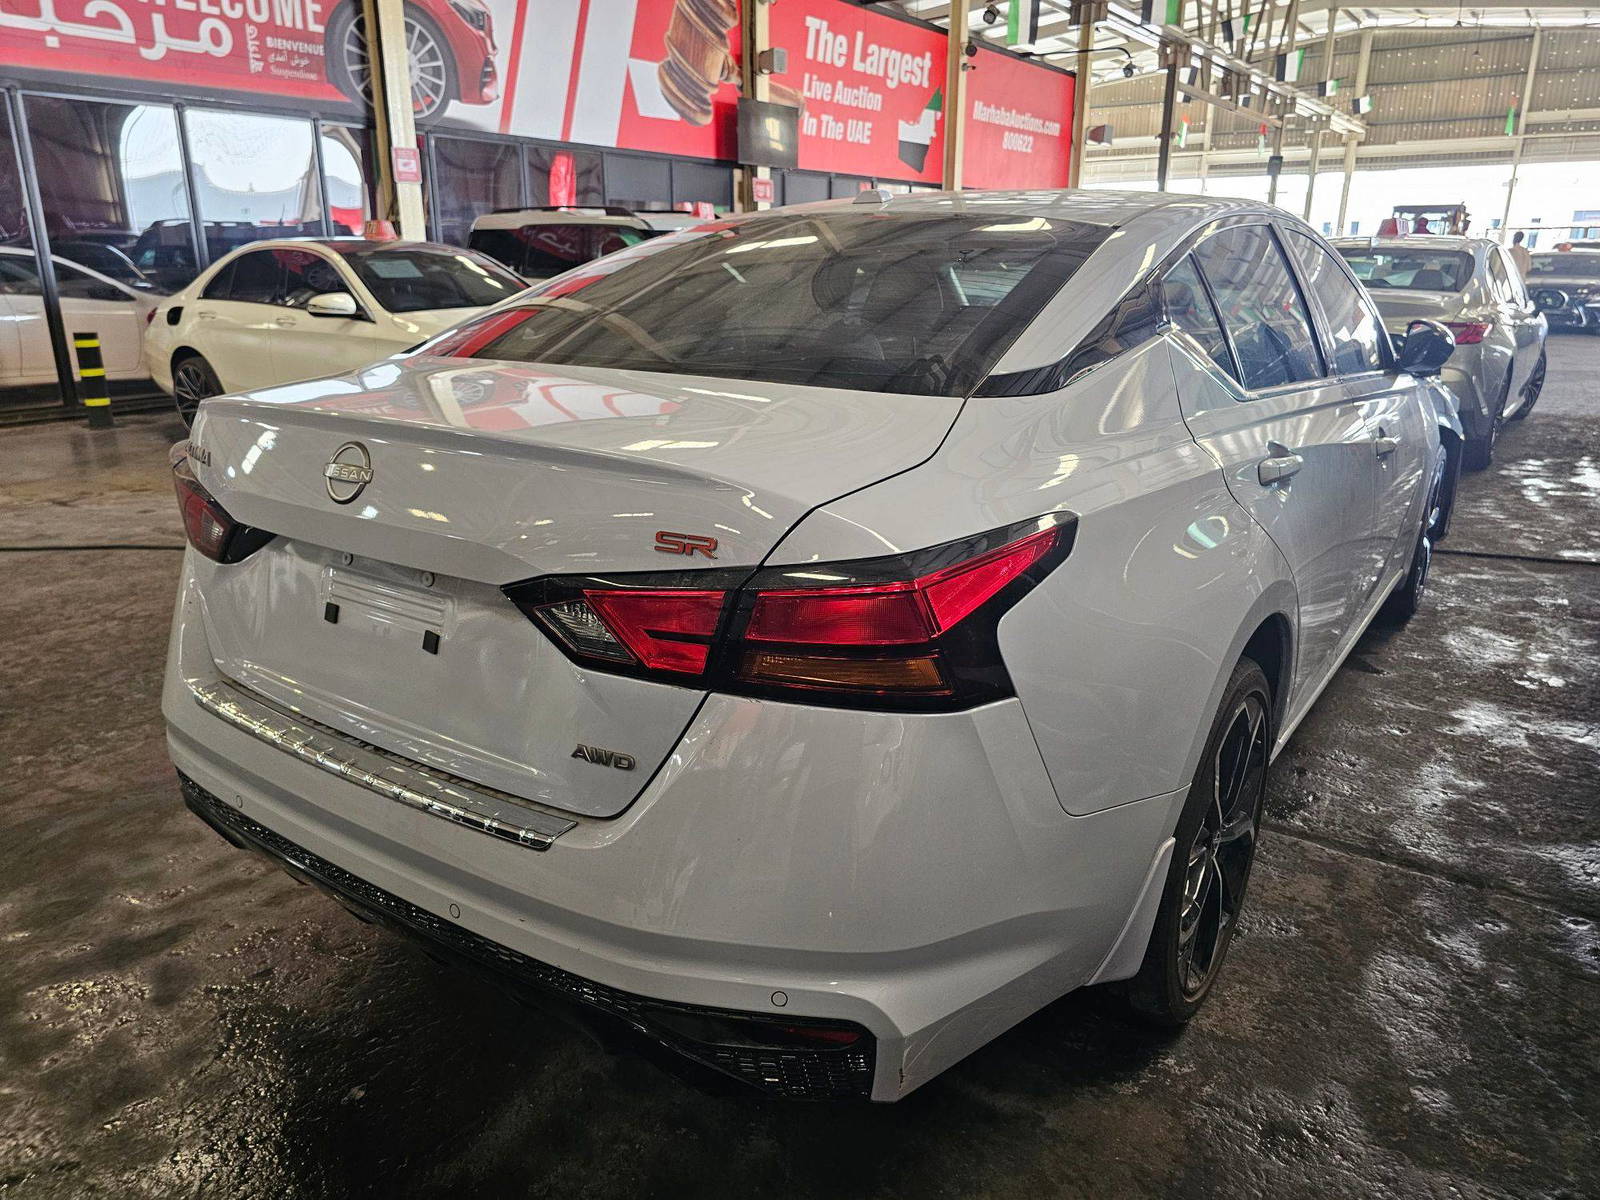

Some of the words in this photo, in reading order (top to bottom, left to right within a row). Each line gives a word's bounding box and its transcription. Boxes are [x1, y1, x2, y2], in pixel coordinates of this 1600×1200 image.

[0, 0, 233, 61] مرحب
[265, 36, 325, 57] BIENVENUE
[805, 15, 848, 68] The
[852, 30, 932, 89] Largest
[803, 72, 833, 102] Live
[833, 80, 882, 112] Auction
[802, 111, 817, 136] In
[820, 114, 844, 141] The
[847, 119, 872, 144] UAE
[654, 530, 719, 560] SR
[571, 743, 636, 771] AWD
